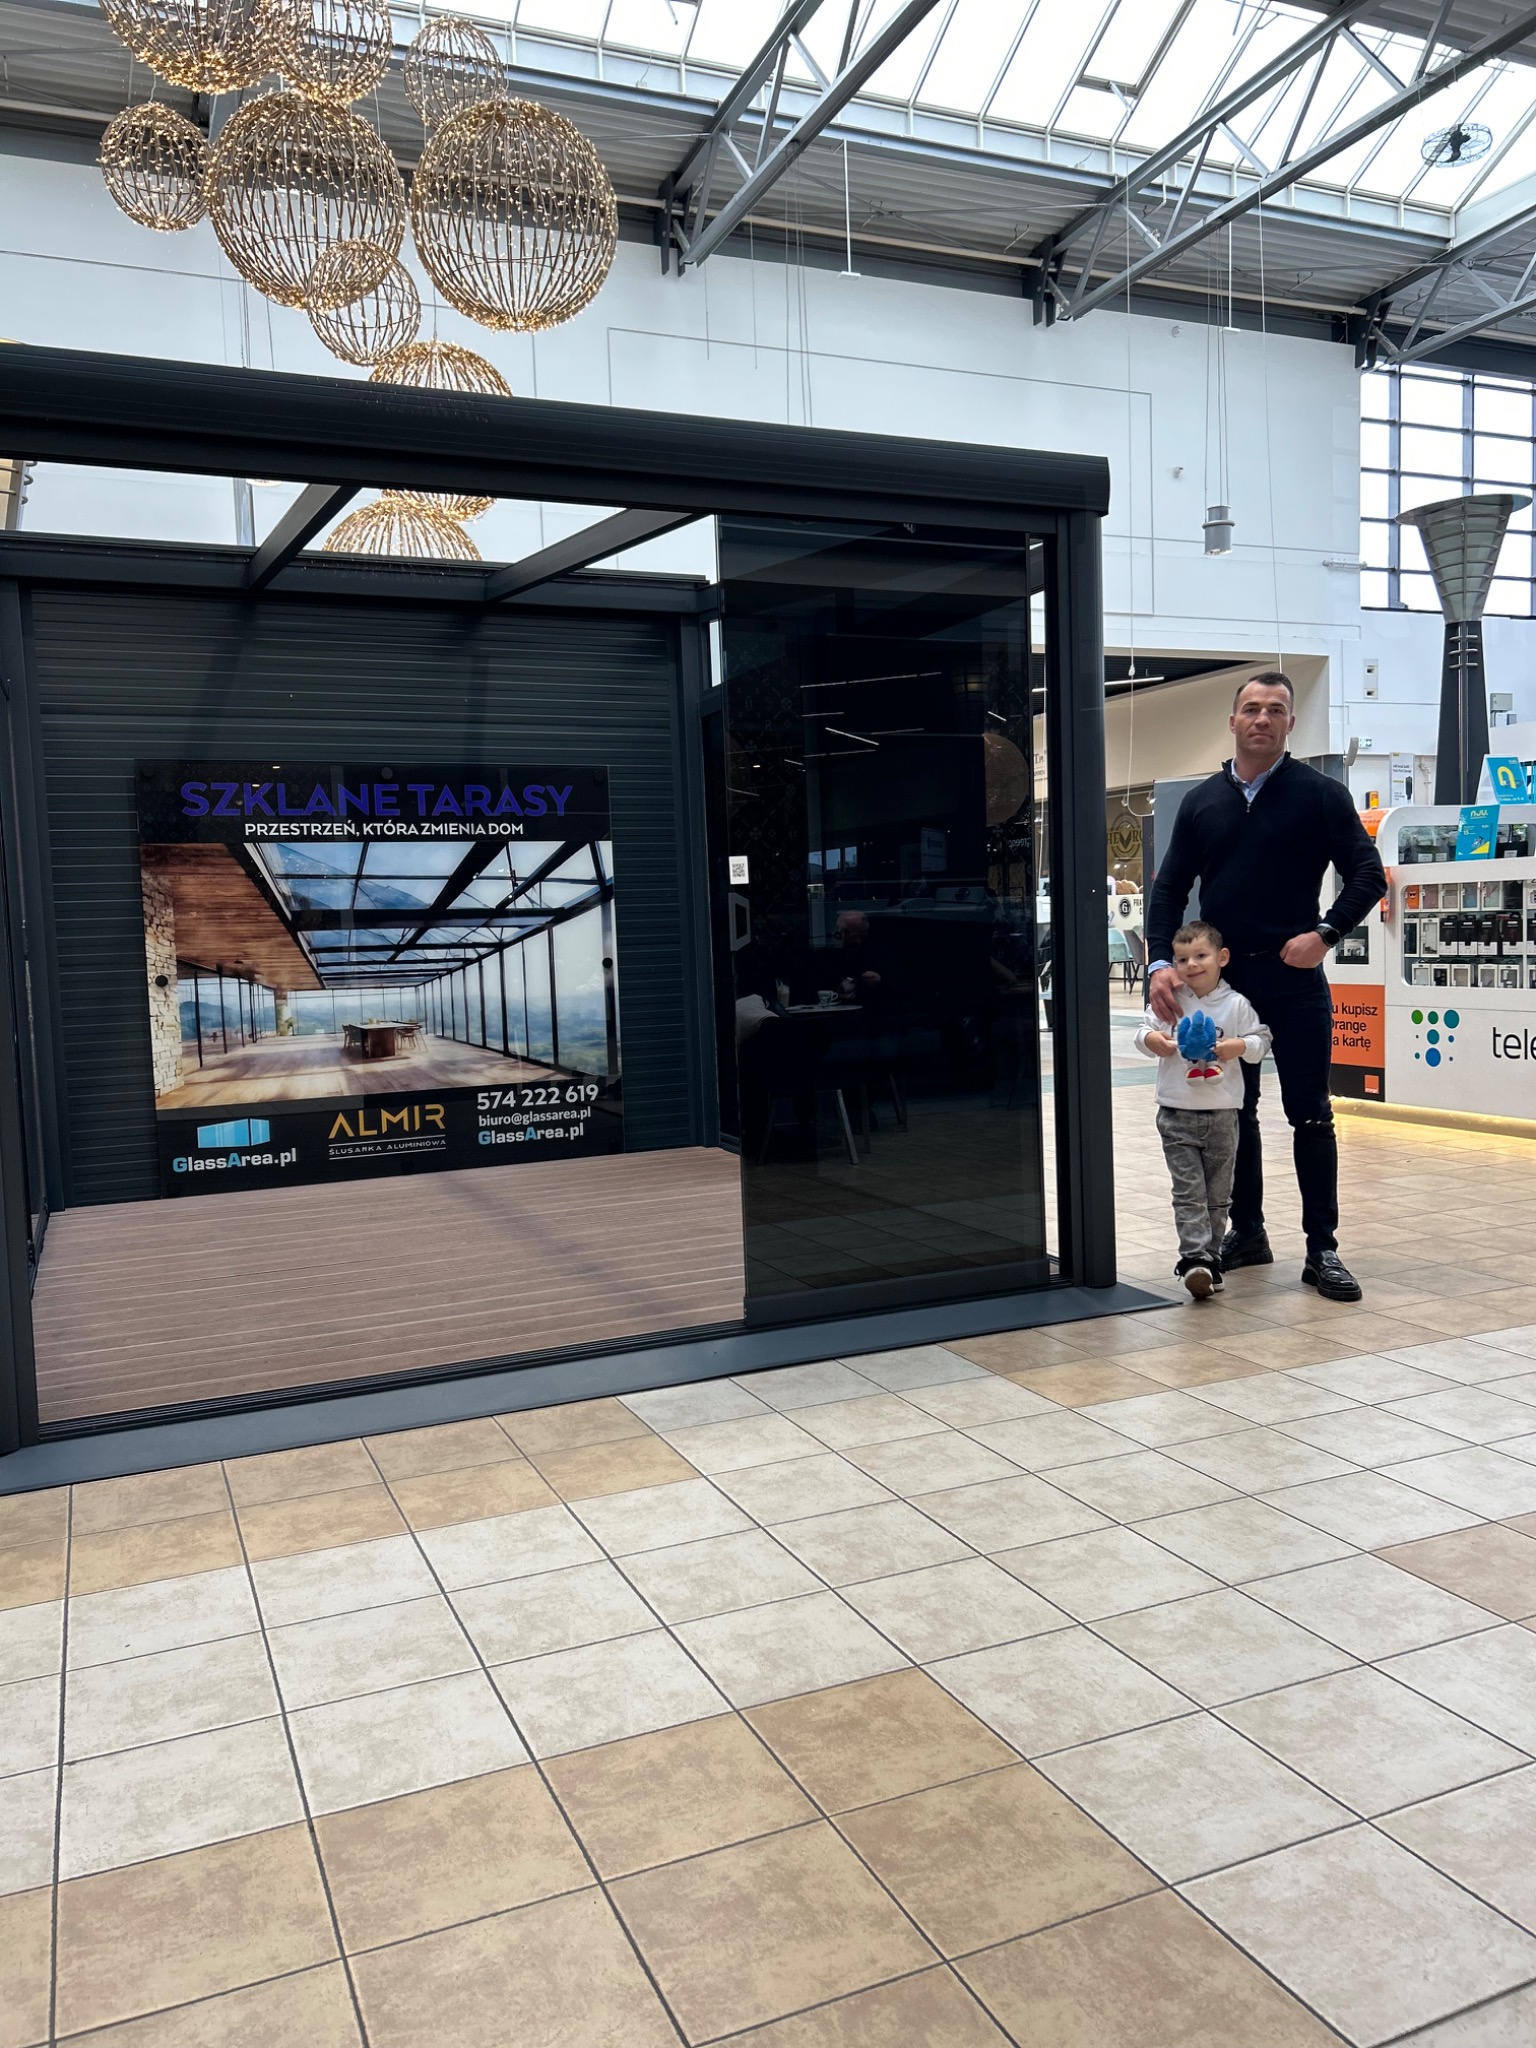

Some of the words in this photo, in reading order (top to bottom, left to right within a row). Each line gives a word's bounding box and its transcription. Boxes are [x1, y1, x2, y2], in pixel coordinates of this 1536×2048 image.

[179, 782, 400, 817] SZKLANE
[407, 784, 574, 817] TARASY
[244, 818, 361, 838] PRZESTRZEŃ,
[362, 818, 419, 837] KTÓRA
[420, 823, 487, 836] ZMIENIA
[488, 823, 524, 836] DOM
[1331, 1004, 1339, 1014] u
[1341, 1002, 1378, 1018] kupisz
[1332, 1036, 1339, 1046] a
[1342, 1034, 1372, 1052] kartę
[476, 1089, 516, 1111] 574
[520, 1086, 561, 1107] 222
[564, 1083, 599, 1103] 619
[328, 1103, 446, 1139] ALMIR
[478, 1106, 592, 1128] biuro@glassarea.pl
[478, 1122, 584, 1146] GlassArea.pl
[328, 1145, 383, 1156] ŚLUSARKA
[386, 1138, 447, 1150] ALUMINIOWA
[172, 1147, 297, 1173] GlassArea.pl
